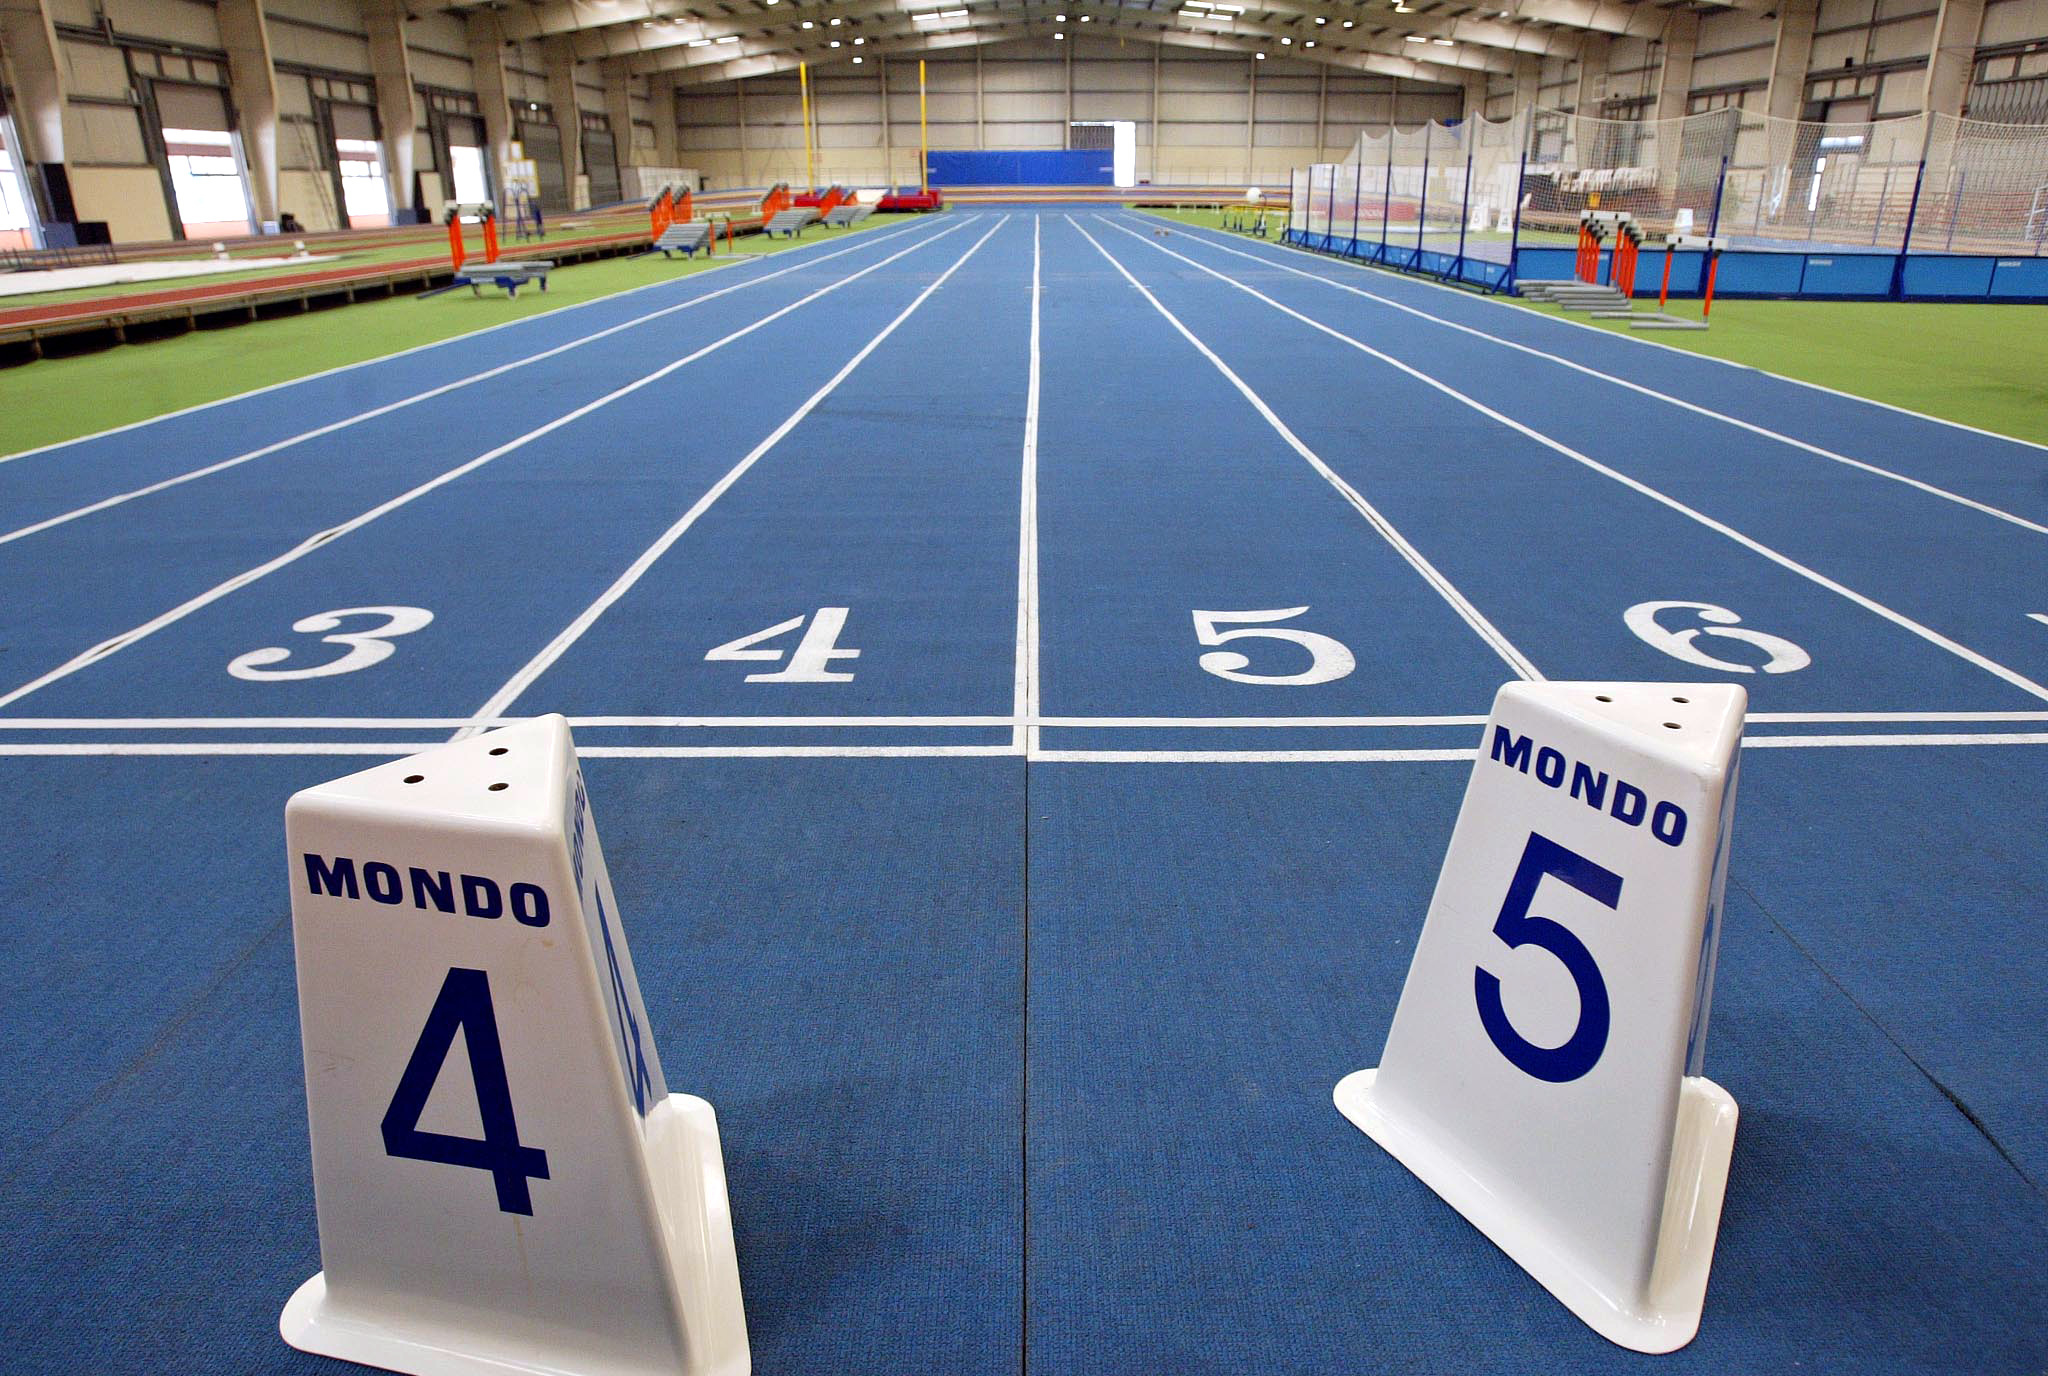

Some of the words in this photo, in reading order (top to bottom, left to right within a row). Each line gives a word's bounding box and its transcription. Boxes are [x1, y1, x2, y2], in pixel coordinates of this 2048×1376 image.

[227, 605, 434, 682] 3
[704, 607, 861, 682] 4
[1192, 606, 1356, 685] 5
[1623, 601, 1811, 674] 6
[1490, 725, 1688, 847] MONDO
[303, 853, 551, 928] MONDO
[1474, 831, 1624, 1083] 5
[380, 967, 551, 1217] 4
